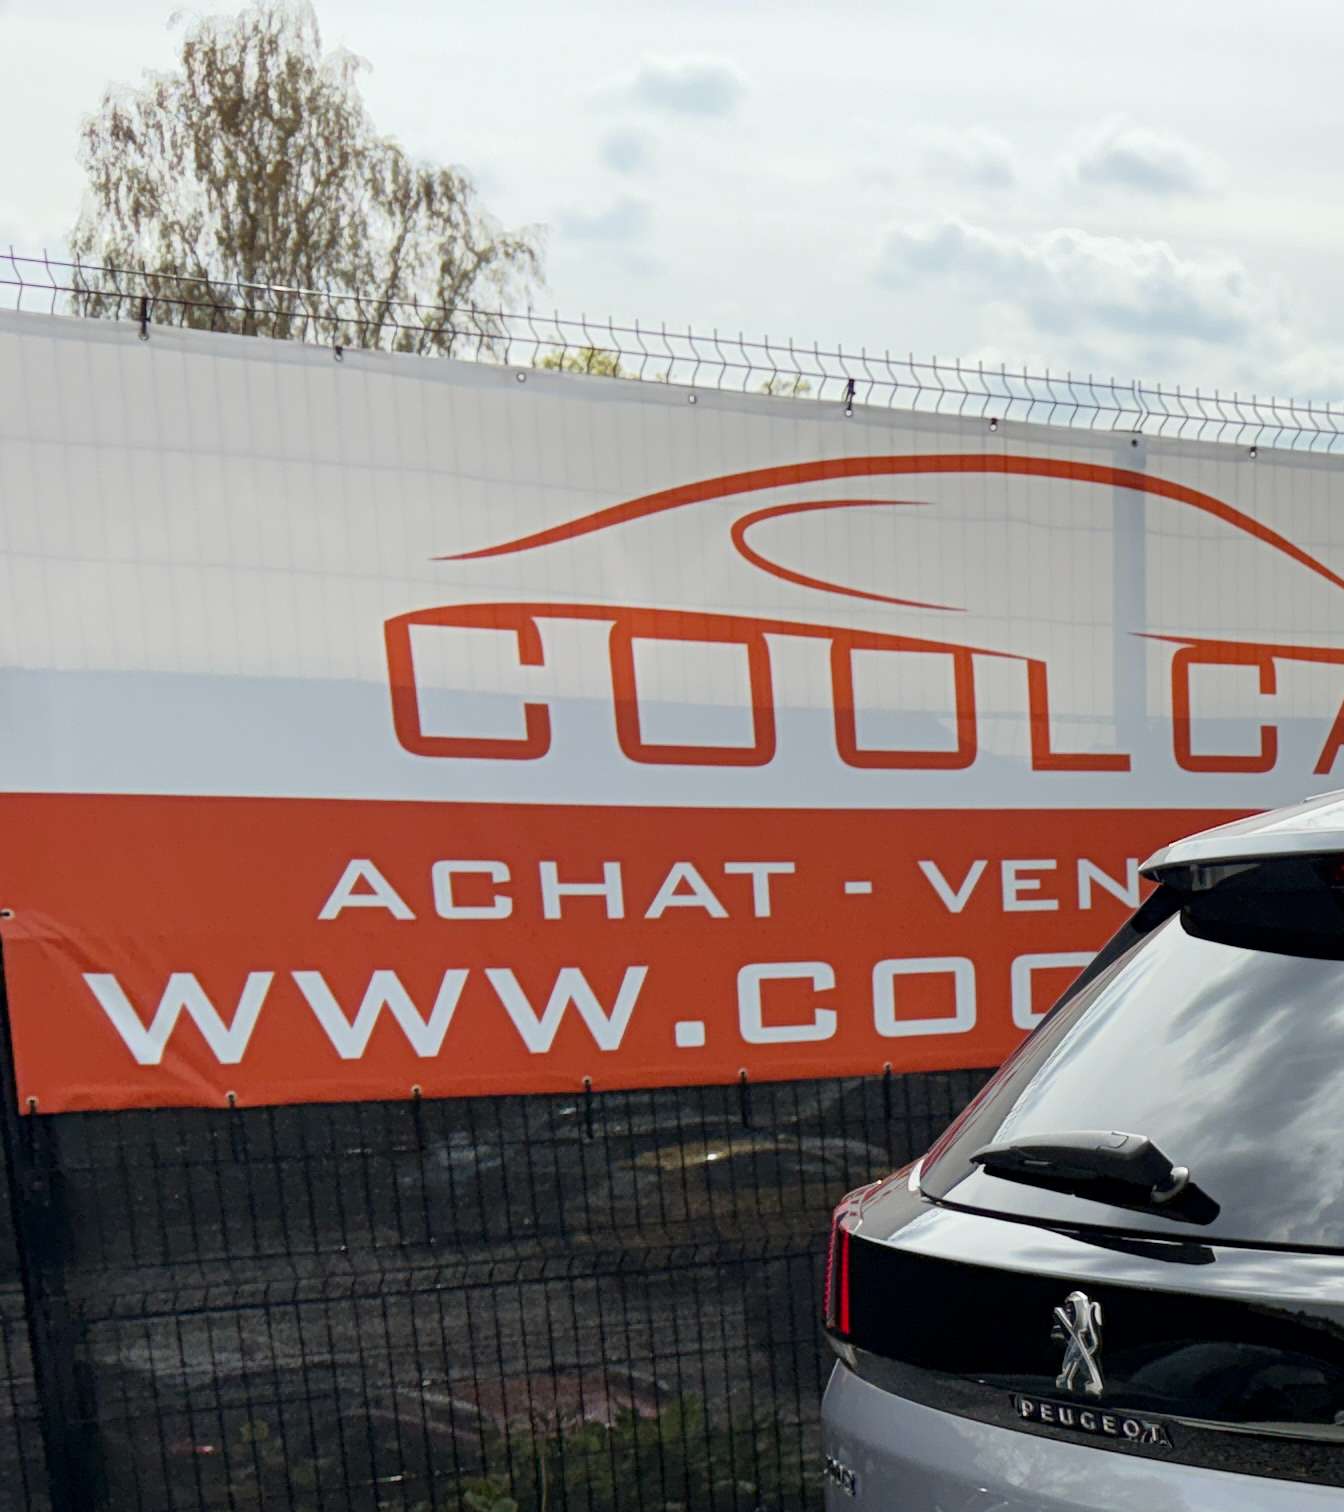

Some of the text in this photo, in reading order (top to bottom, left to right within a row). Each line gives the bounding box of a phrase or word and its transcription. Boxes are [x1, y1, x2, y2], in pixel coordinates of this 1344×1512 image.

[318, 858, 1142, 920] ACHAT - VEN
[1021, 1399, 1167, 1443] PEUGEOT
